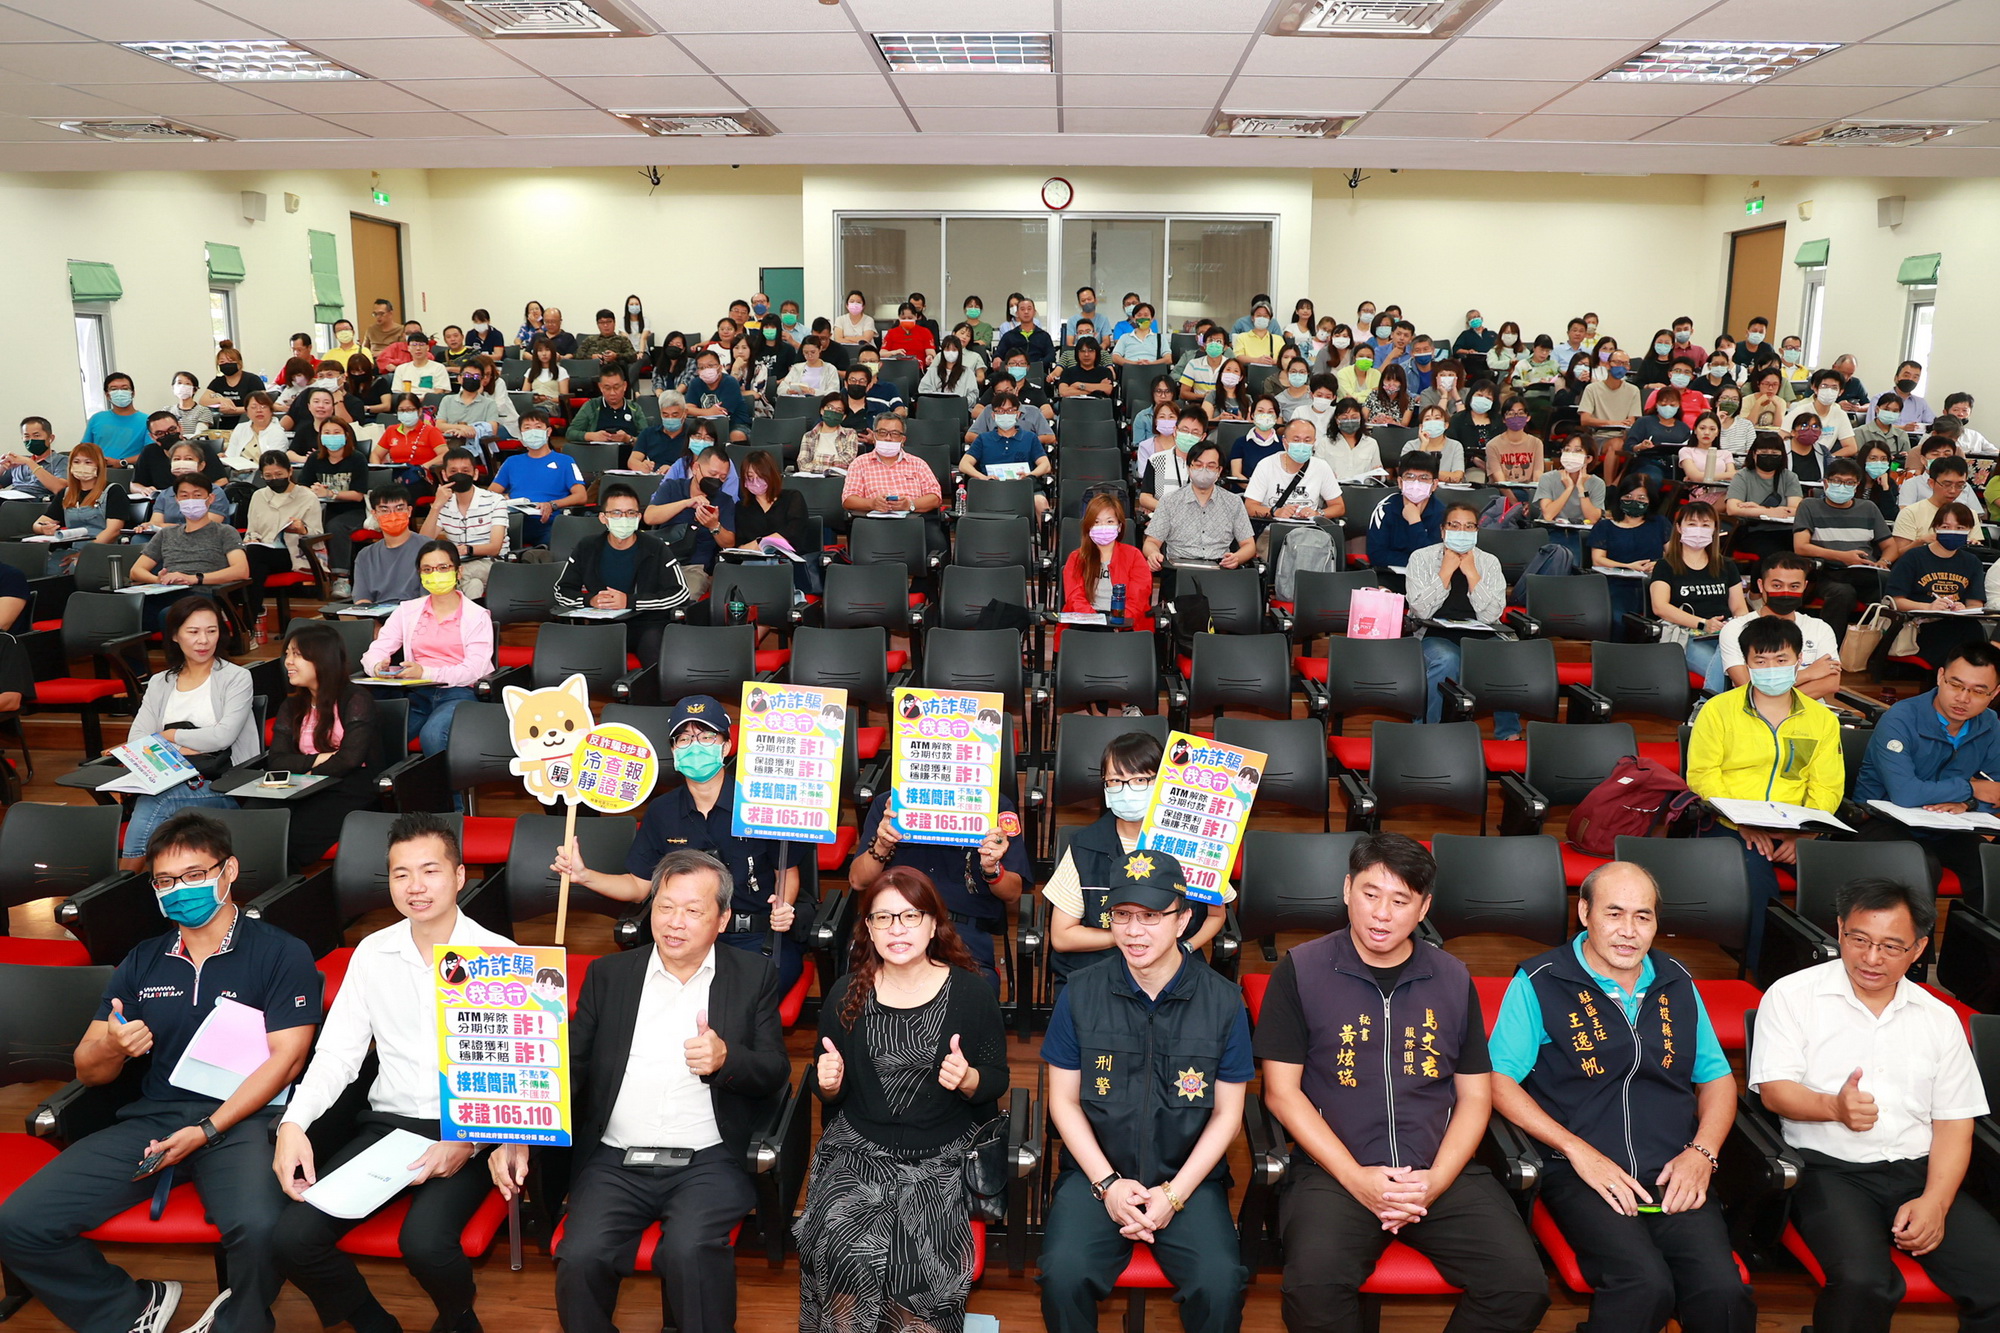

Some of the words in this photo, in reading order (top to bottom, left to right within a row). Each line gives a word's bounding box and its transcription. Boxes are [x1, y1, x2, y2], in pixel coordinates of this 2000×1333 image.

[1696, 583, 1726, 595] STREET
[769, 693, 822, 710] 防詐騙
[922, 697, 977, 716] 防詐騙
[756, 735, 775, 744] ATM
[910, 741, 930, 750] ATM
[931, 742, 952, 751] 解除
[910, 750, 952, 760] 分期付款
[1191, 748, 1243, 771] 防詐騙
[1168, 796, 1206, 812] 分期付款
[1170, 787, 1189, 799] ATM
[1189, 791, 1208, 803] 解除
[748, 806, 773, 825] 求證
[776, 809, 823, 828] 165.110
[905, 812, 932, 830] 求證
[934, 814, 983, 833] 165.110
[468, 954, 535, 979] 防詐騙
[467, 983, 526, 1005] 我最行
[458, 1012, 481, 1022] ATM
[483, 1013, 508, 1023] 解除
[1578, 990, 1607, 1041] 駐區主任
[458, 1023, 508, 1034] 分期付款
[1658, 994, 1675, 1069] 南投縣政府
[459, 1040, 509, 1051] 保證獲利
[1404, 1026, 1417, 1076] 服務團隊
[1420, 1008, 1440, 1078] 馬文君
[1568, 1012, 1605, 1077] 王逸帆
[459, 1051, 509, 1063] 穩賺不賠
[1336, 1024, 1358, 1088] 黃炫瑞
[457, 1071, 517, 1094] 接獲簡訊
[519, 1069, 549, 1079] 不點擊
[1095, 1054, 1113, 1096] 刑警
[519, 1079, 550, 1089] 不傳輸
[519, 1089, 550, 1099] 不匯款
[458, 1103, 491, 1125] 求證
[493, 1104, 553, 1126] 165.110
